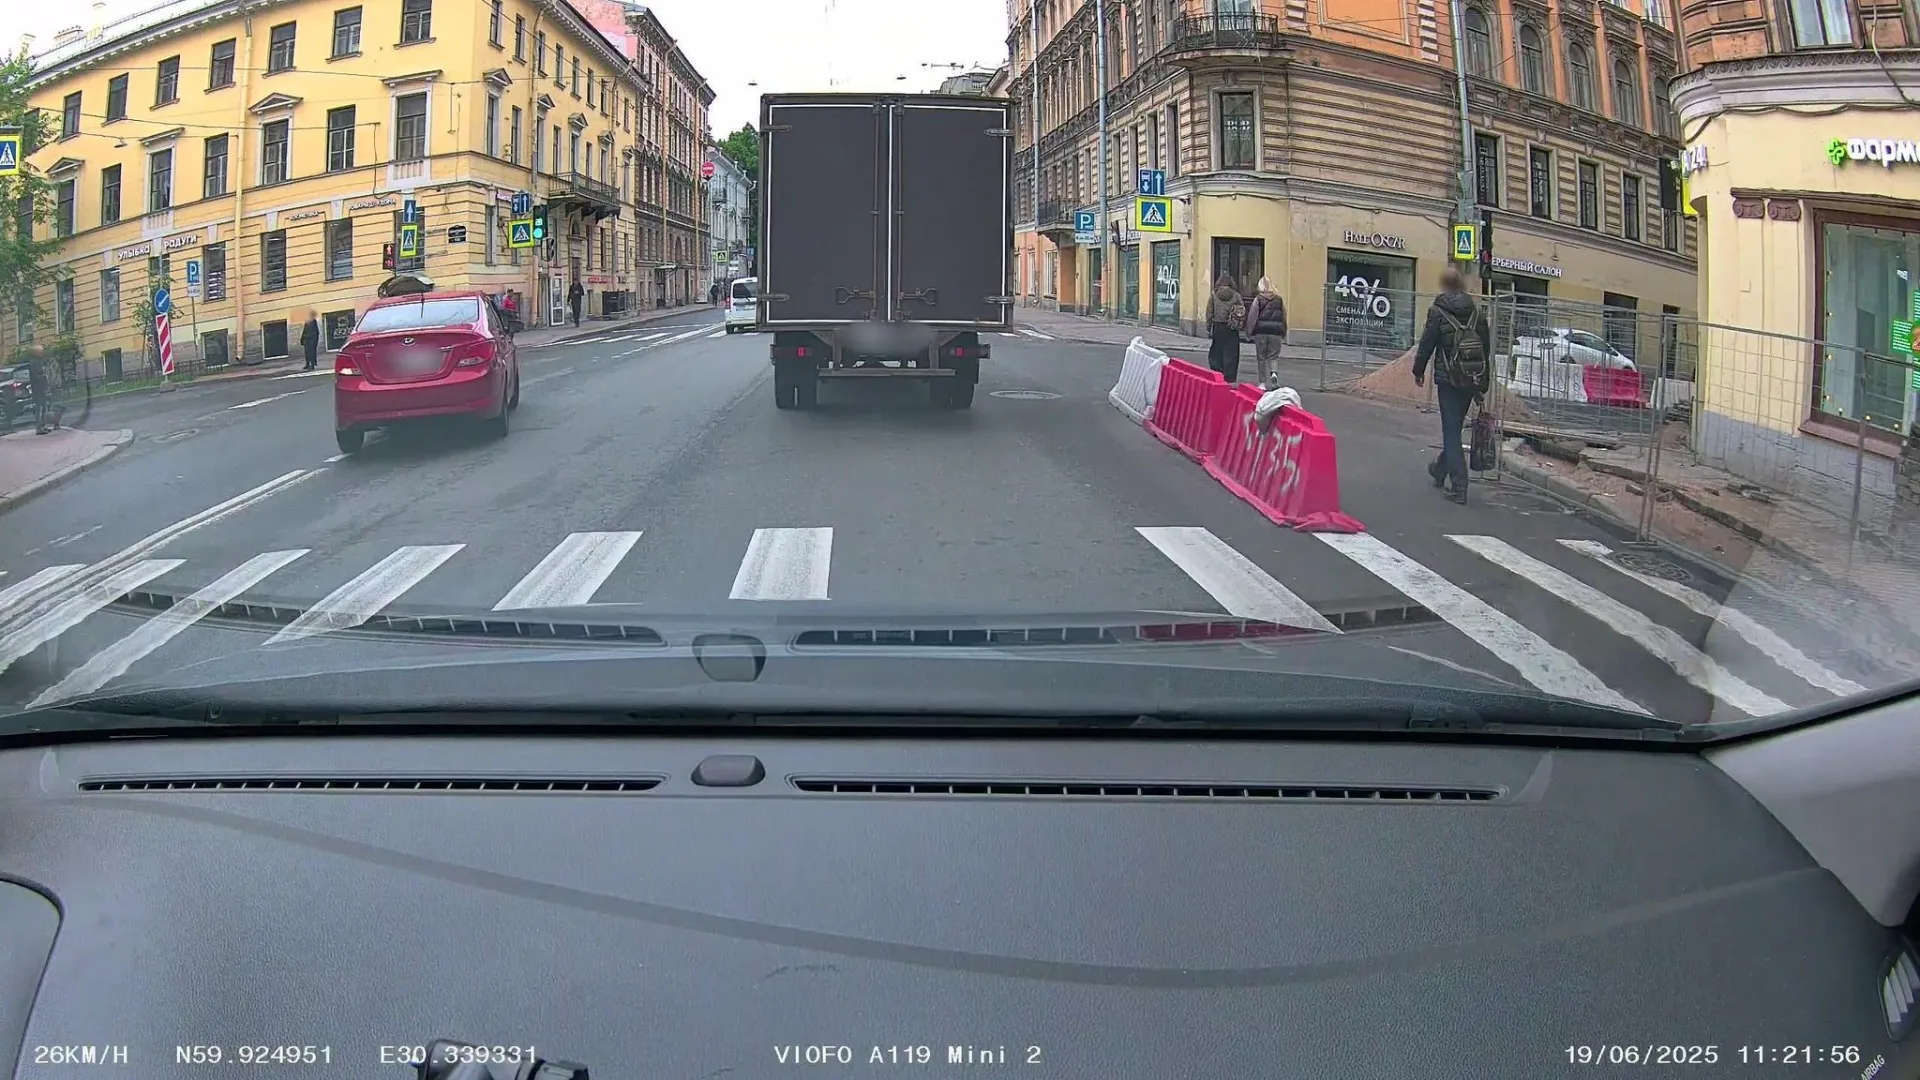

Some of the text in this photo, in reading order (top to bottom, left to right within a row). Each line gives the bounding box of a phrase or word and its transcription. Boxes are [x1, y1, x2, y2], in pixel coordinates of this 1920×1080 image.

[1847, 138, 1920, 167] фарм
[1371, 232, 1406, 249] OSCAR
[1534, 264, 1562, 277] САЛОН
[1336, 305, 1361, 315] СМЕНА
